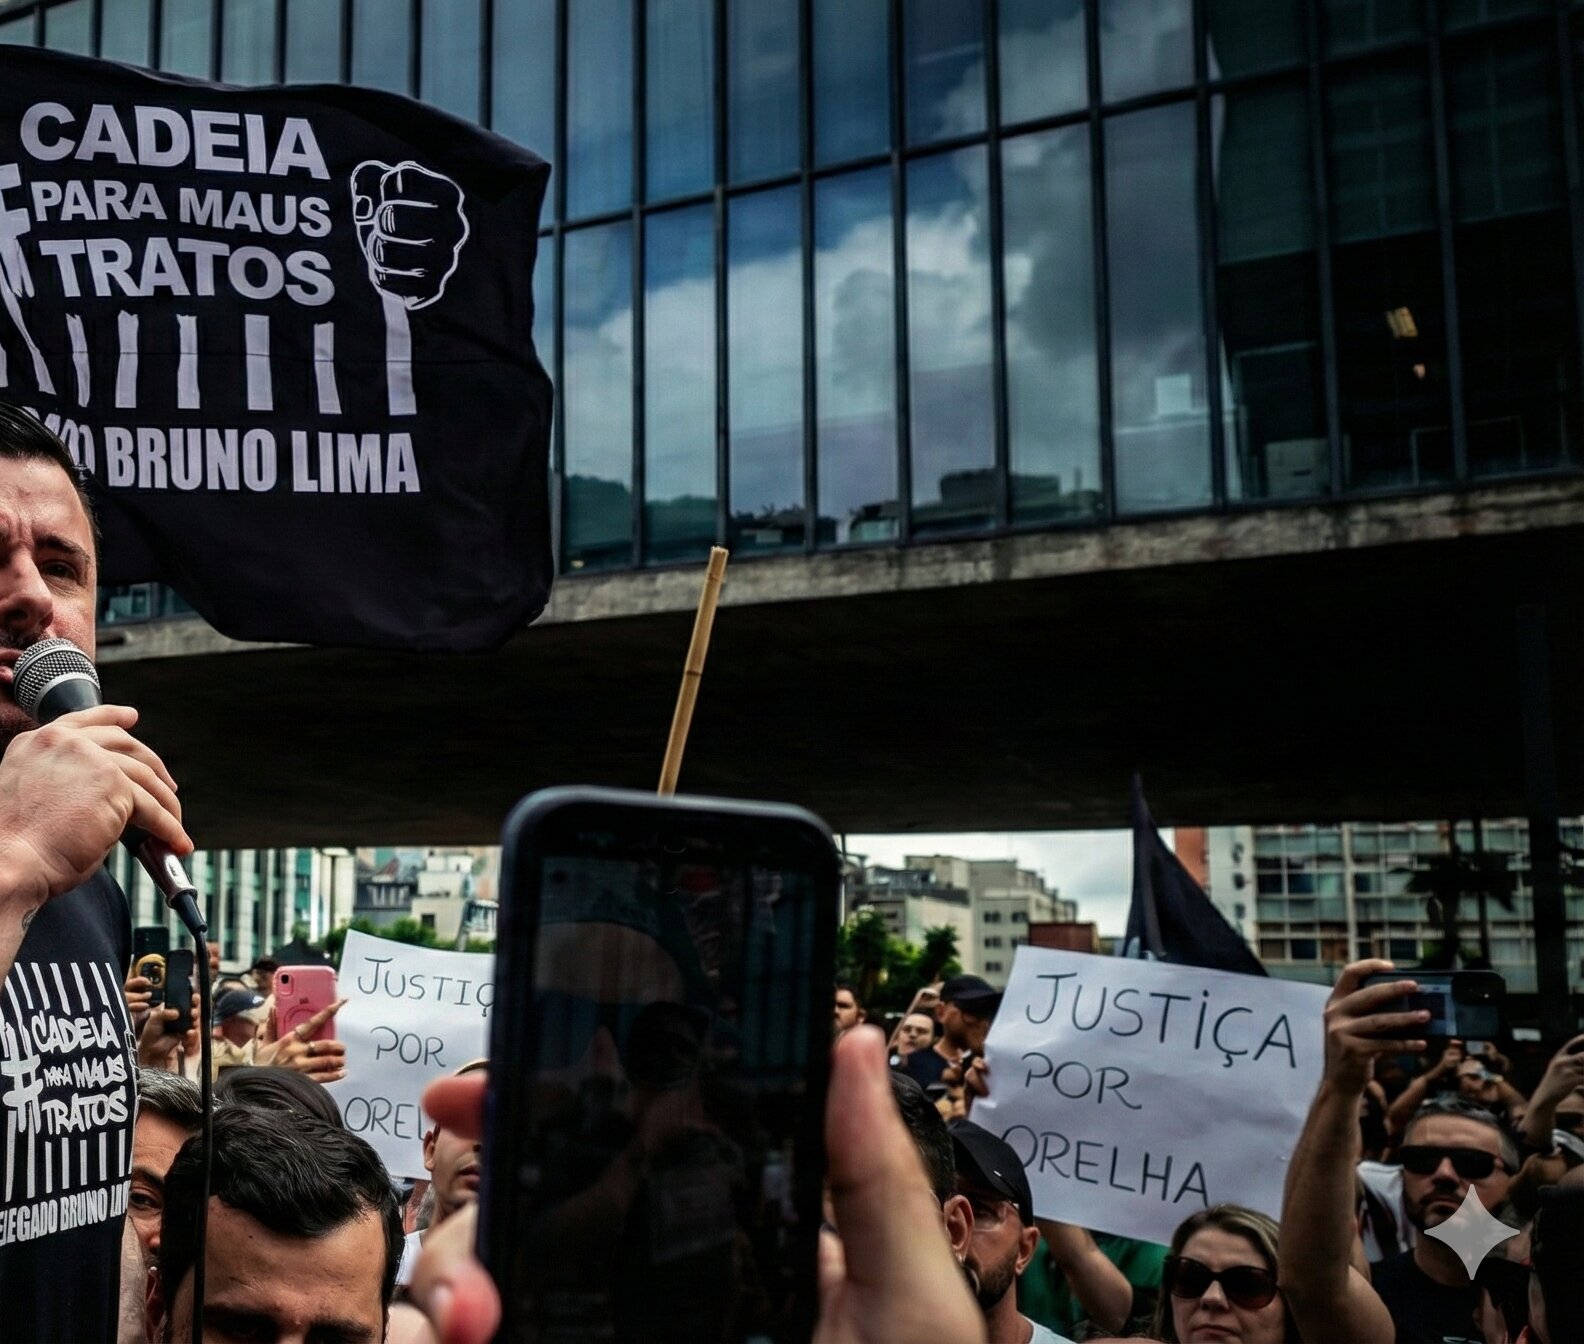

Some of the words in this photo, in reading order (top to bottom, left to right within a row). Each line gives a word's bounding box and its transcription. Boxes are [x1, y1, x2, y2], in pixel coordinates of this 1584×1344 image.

[20, 102, 331, 180] CADEIA
[31, 180, 168, 222] PARA
[179, 187, 332, 238] MAUS
[39, 237, 335, 307] TRATOS
[104, 426, 278, 492] BRUNO
[292, 430, 421, 493] LIMA
[31, 1010, 122, 1054] CADEIA
[369, 1026, 447, 1068] POR
[72, 1054, 128, 1089] MAUS
[1021, 1052, 1143, 1110] POR
[41, 1085, 129, 1136] TRATOS
[1002, 1124, 1210, 1209] ORELHA
[59, 1187, 108, 1232] BRUNO
